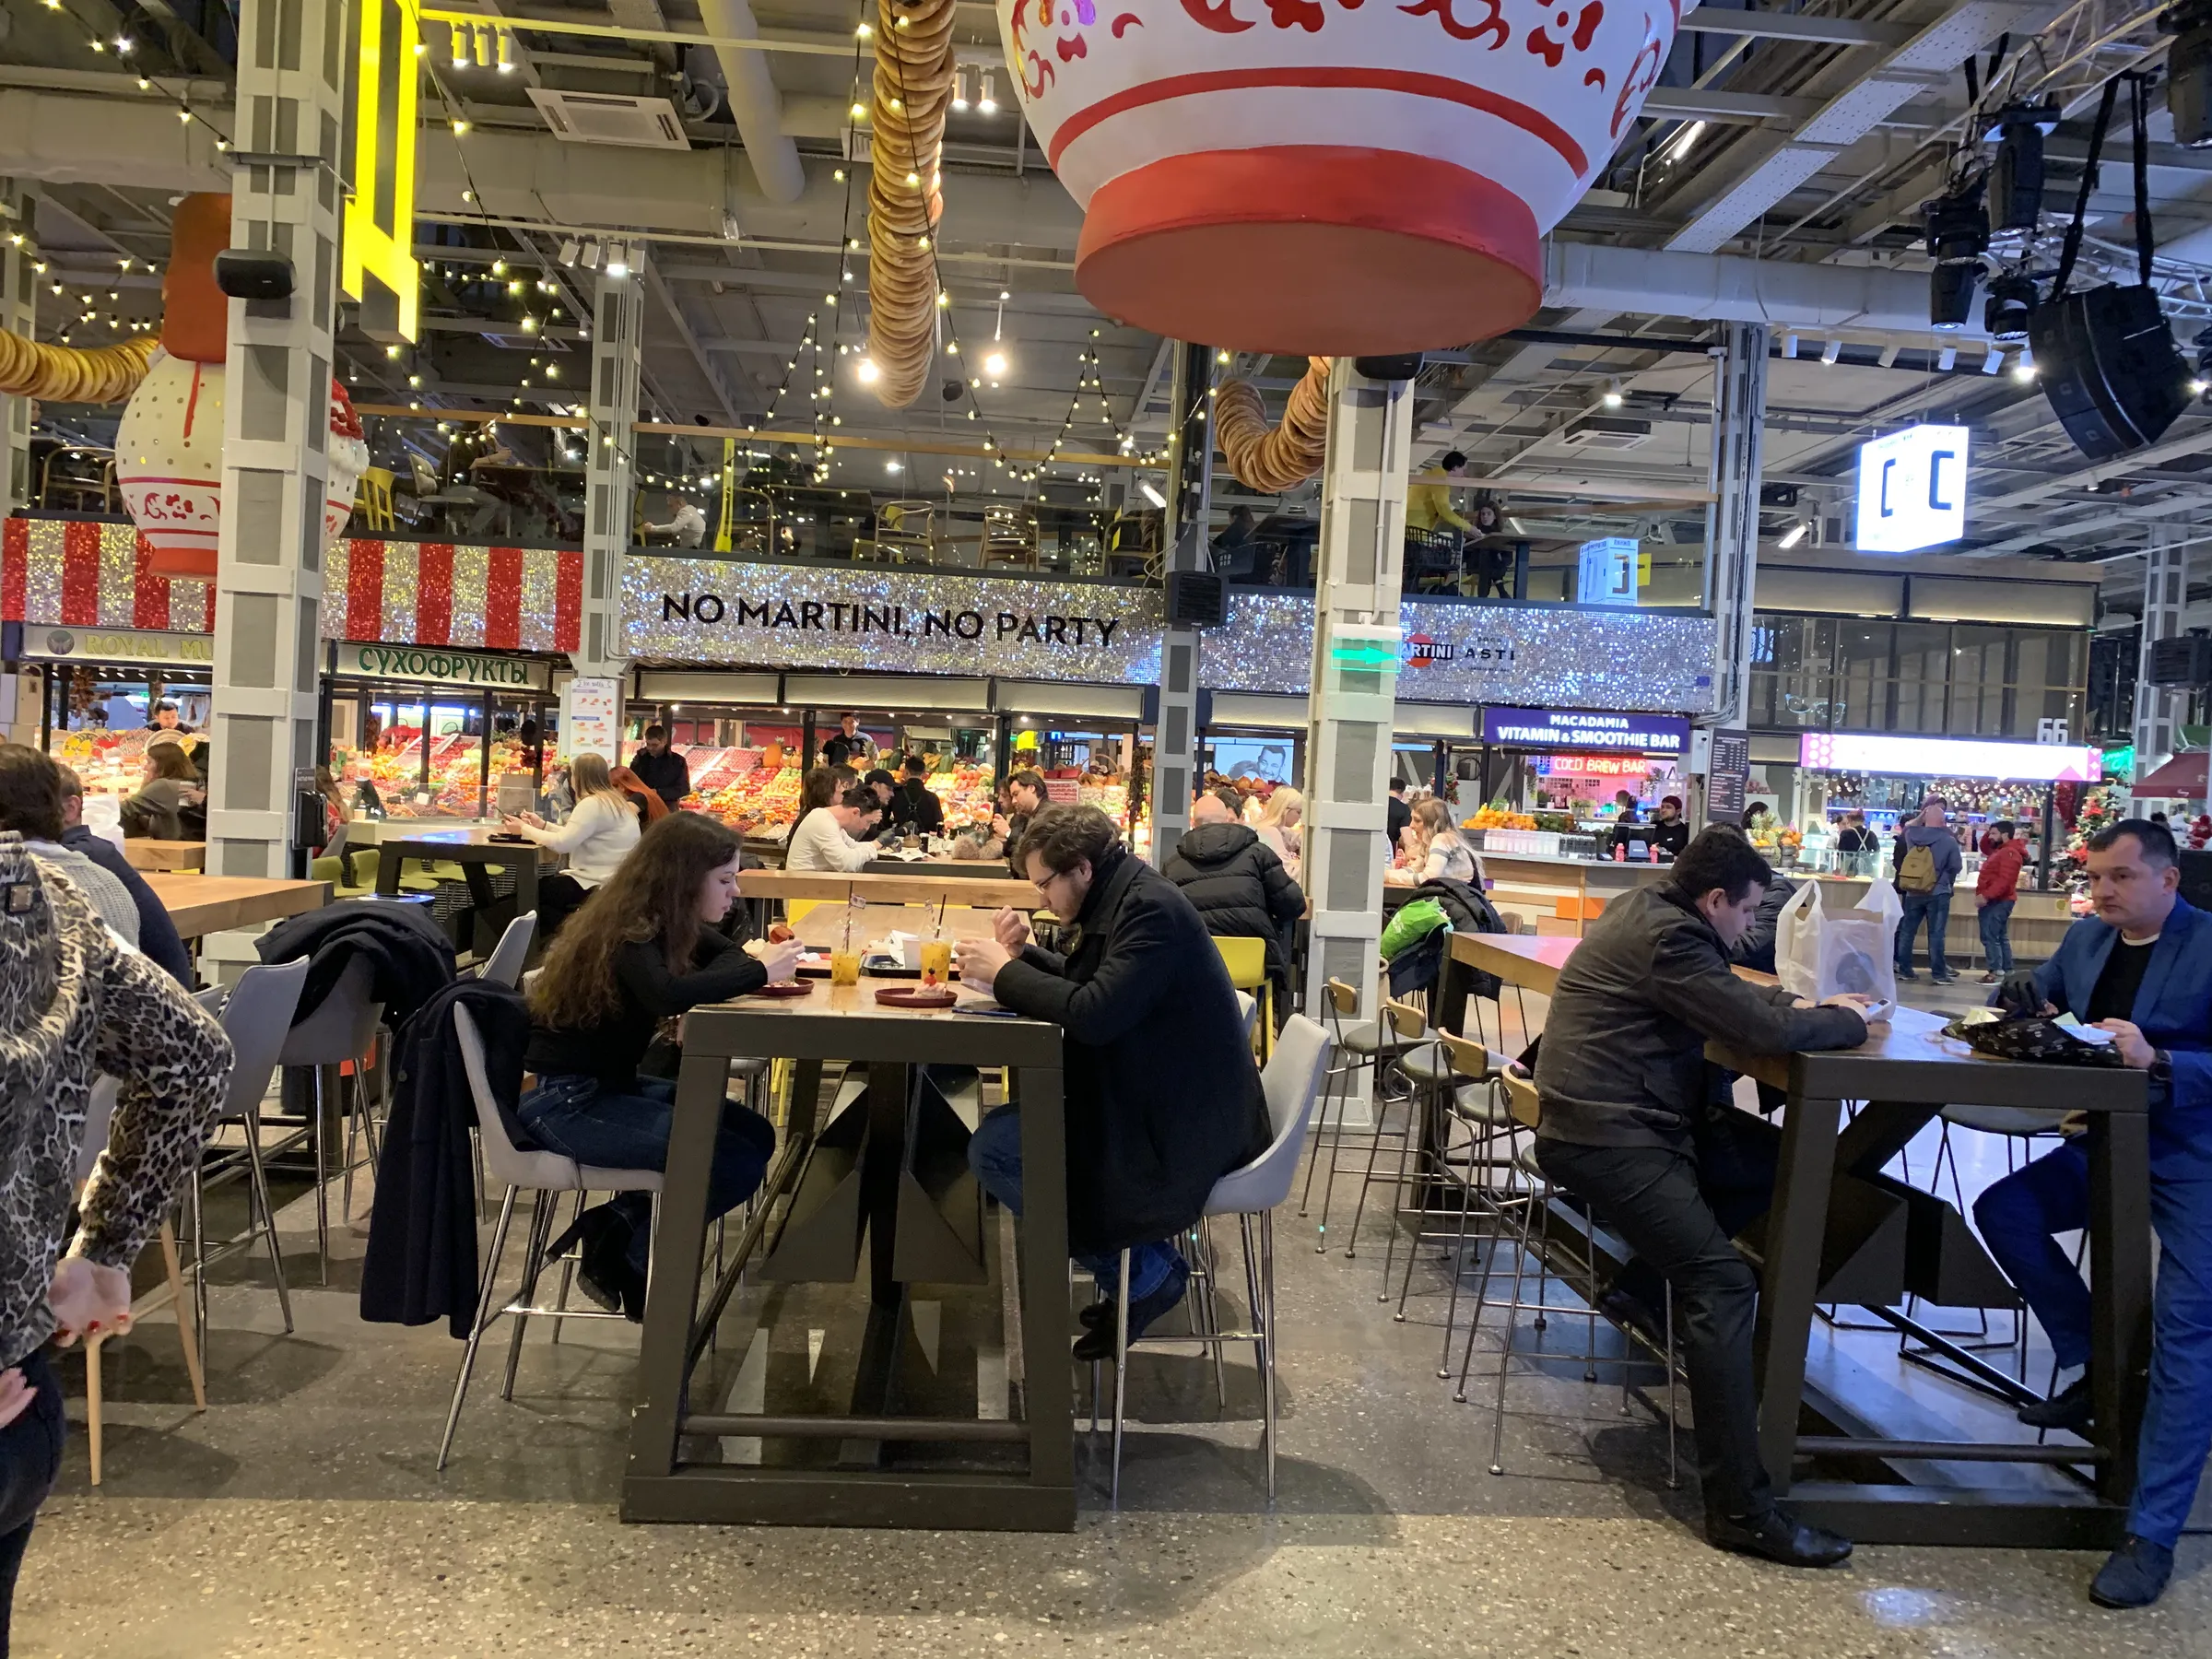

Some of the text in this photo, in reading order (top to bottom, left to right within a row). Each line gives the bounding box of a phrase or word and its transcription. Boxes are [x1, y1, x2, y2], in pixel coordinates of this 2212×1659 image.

[663, 593, 1119, 646] NO MARTINI, NO PARTY
[84, 633, 169, 658] ROYAL
[1400, 642, 1453, 659] ARTINI
[1465, 648, 1515, 661] ASTI
[358, 647, 530, 685] СУХОФРУКТЫ
[1549, 714, 1630, 729] MACADAMIA
[2036, 717, 2069, 747] 66
[1497, 726, 1681, 749] VITAMIN & SMOOTHIE BAR
[1554, 758, 1646, 774] COLD BREW BAR
